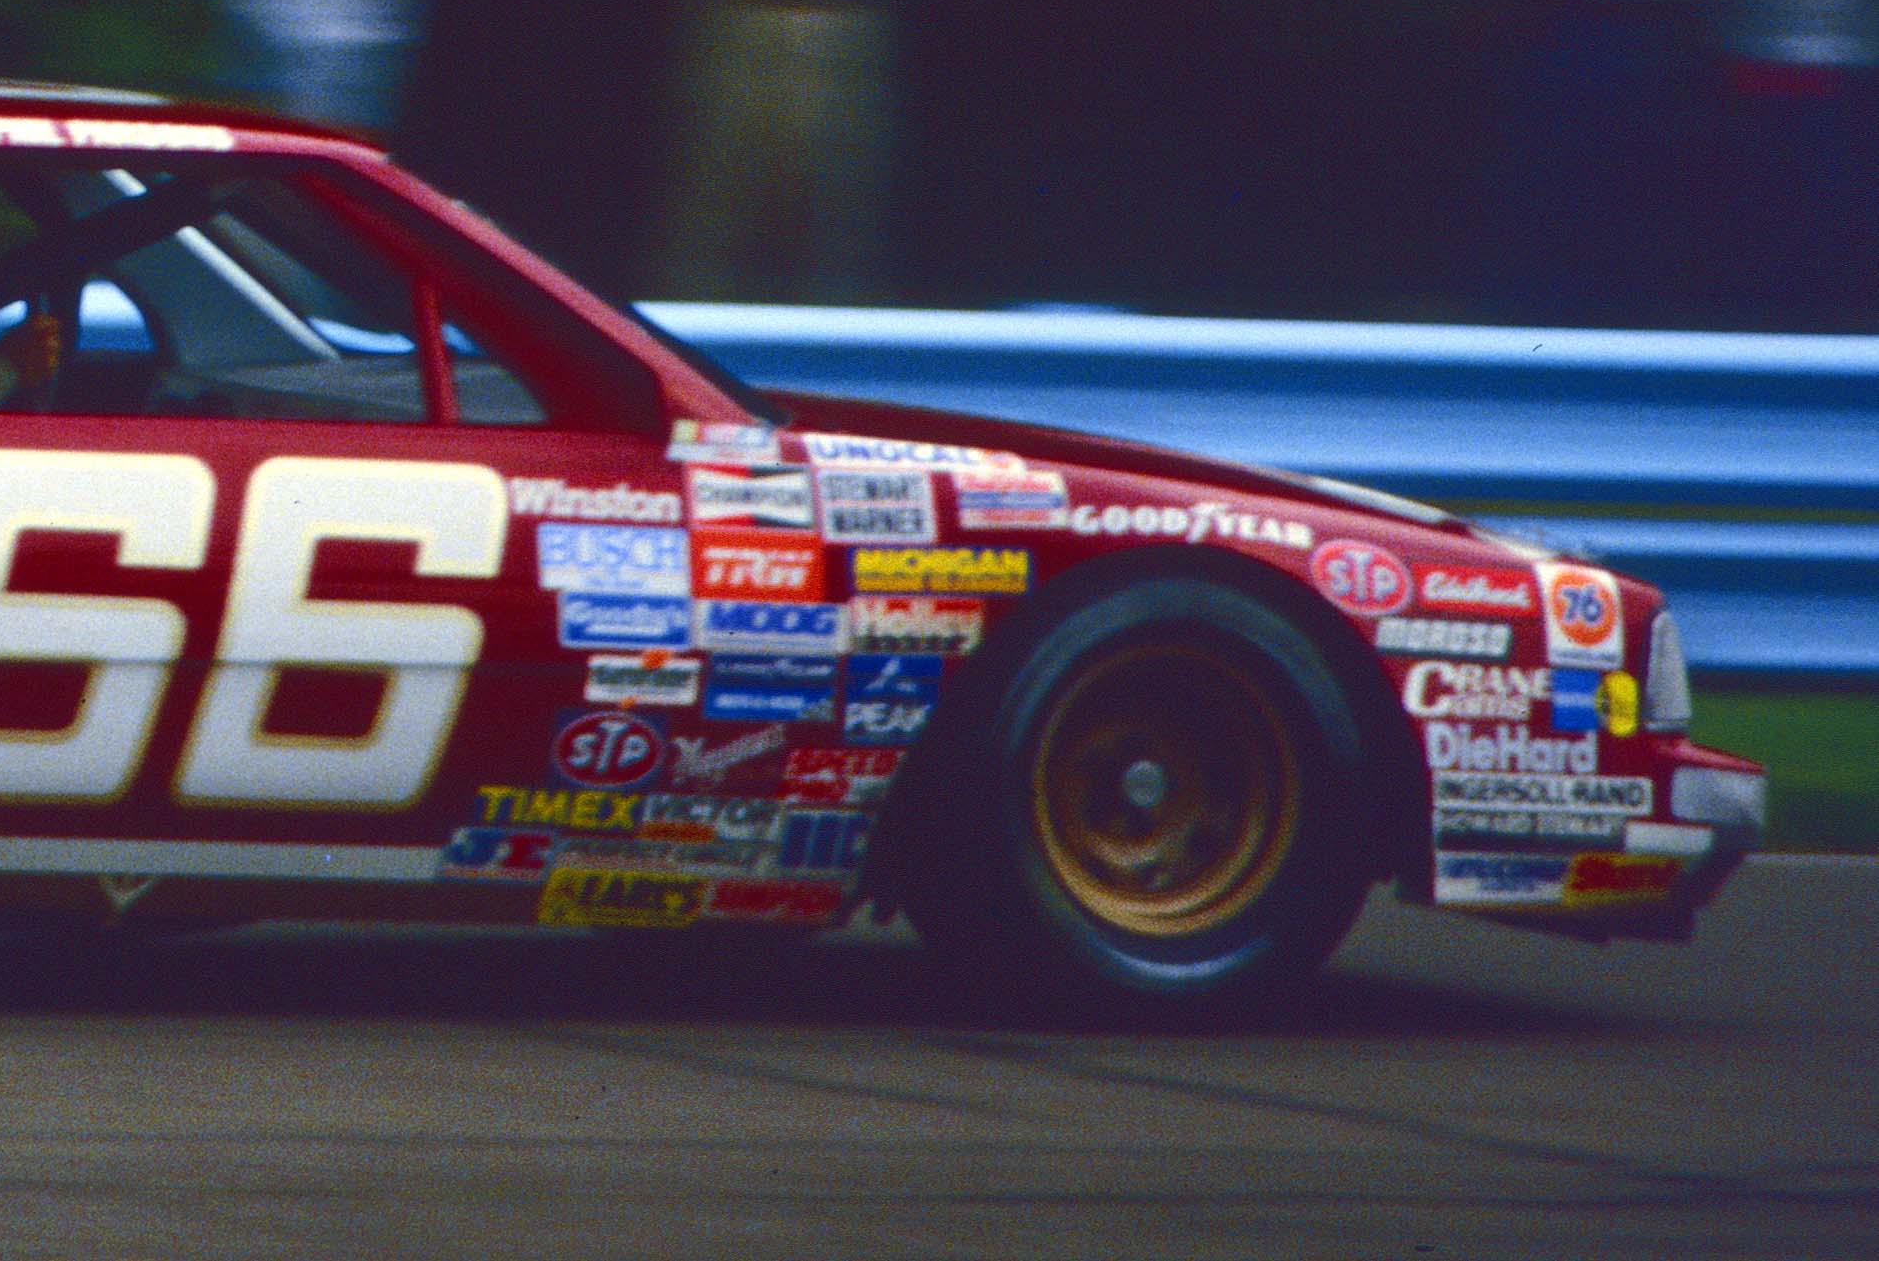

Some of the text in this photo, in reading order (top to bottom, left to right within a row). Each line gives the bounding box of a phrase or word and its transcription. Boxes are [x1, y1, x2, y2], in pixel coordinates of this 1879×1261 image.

[509, 476, 682, 523] Winston
[702, 548, 815, 587] TRW
[1325, 550, 1399, 604] STP
[1558, 585, 1604, 624] 76
[564, 716, 650, 775] STP
[1425, 722, 1598, 774] DieHard
[477, 785, 640, 830] TIMEX
